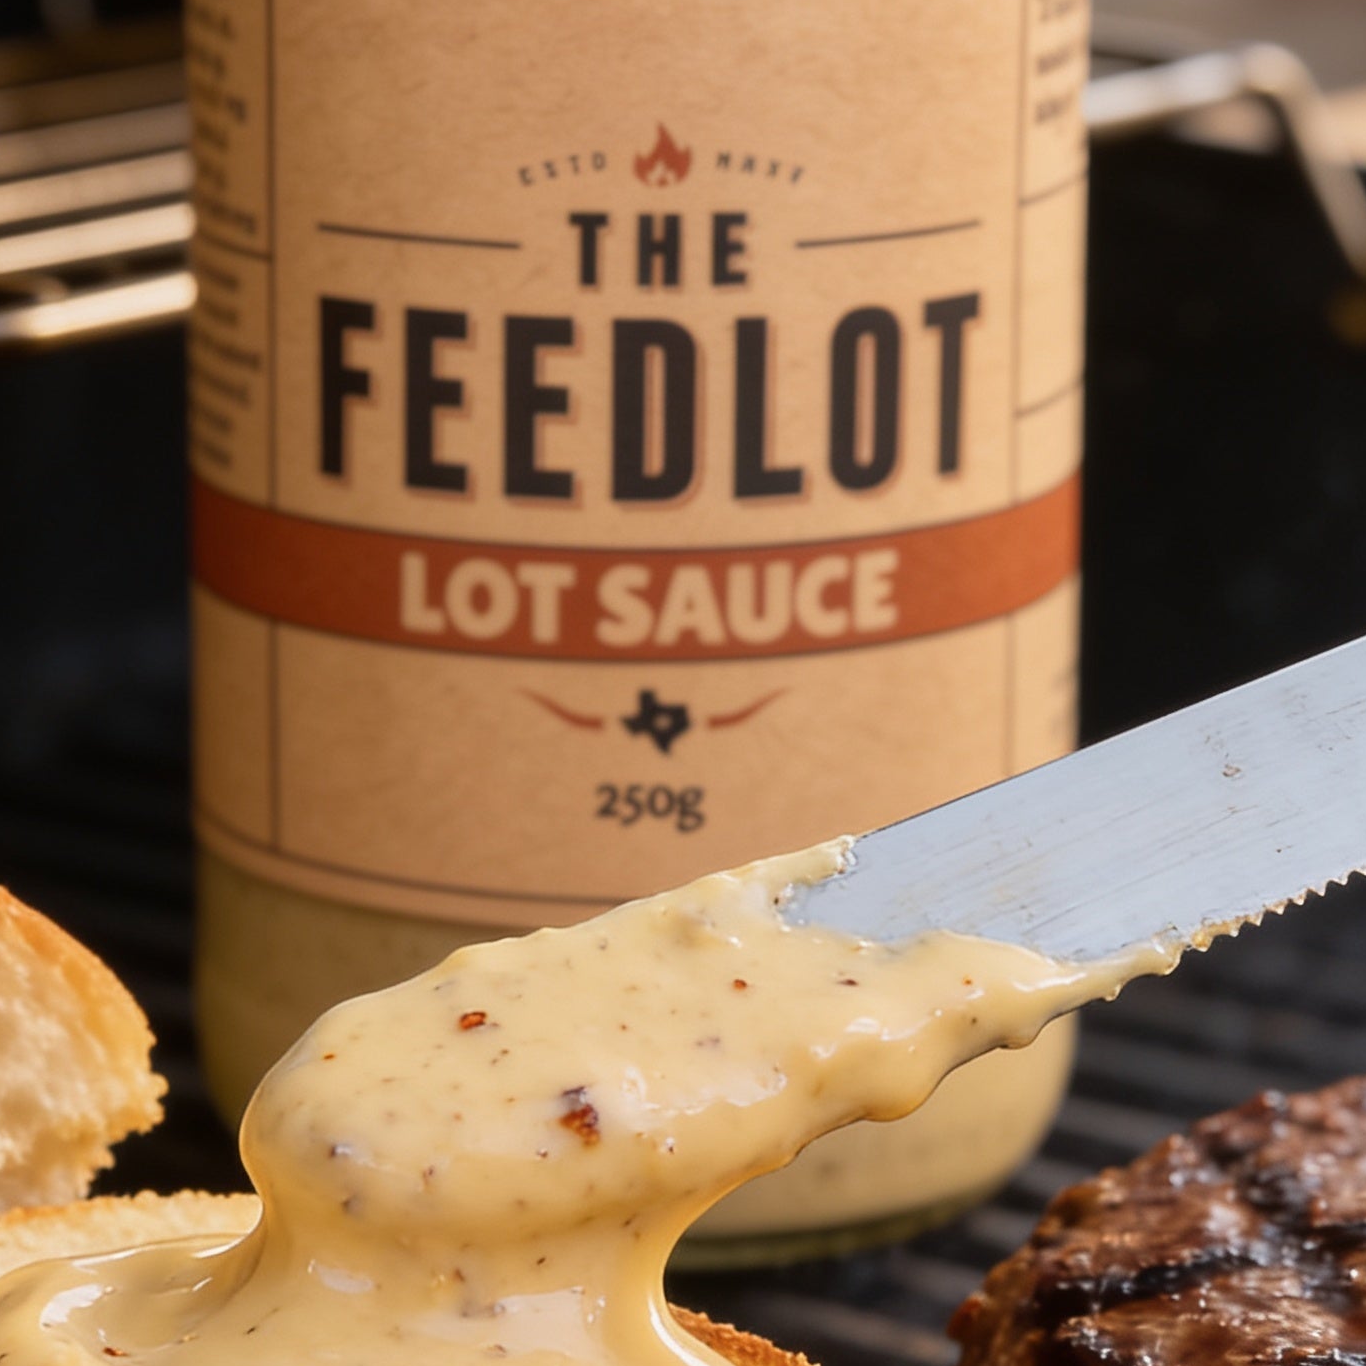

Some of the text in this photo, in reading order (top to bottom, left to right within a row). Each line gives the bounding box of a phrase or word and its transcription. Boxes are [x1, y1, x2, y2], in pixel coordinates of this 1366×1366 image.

[568, 212, 749, 287] THE
[318, 292, 981, 505] FEEDLOT
[399, 548, 900, 647] LOT SAUCE
[594, 782, 705, 835] 250g
